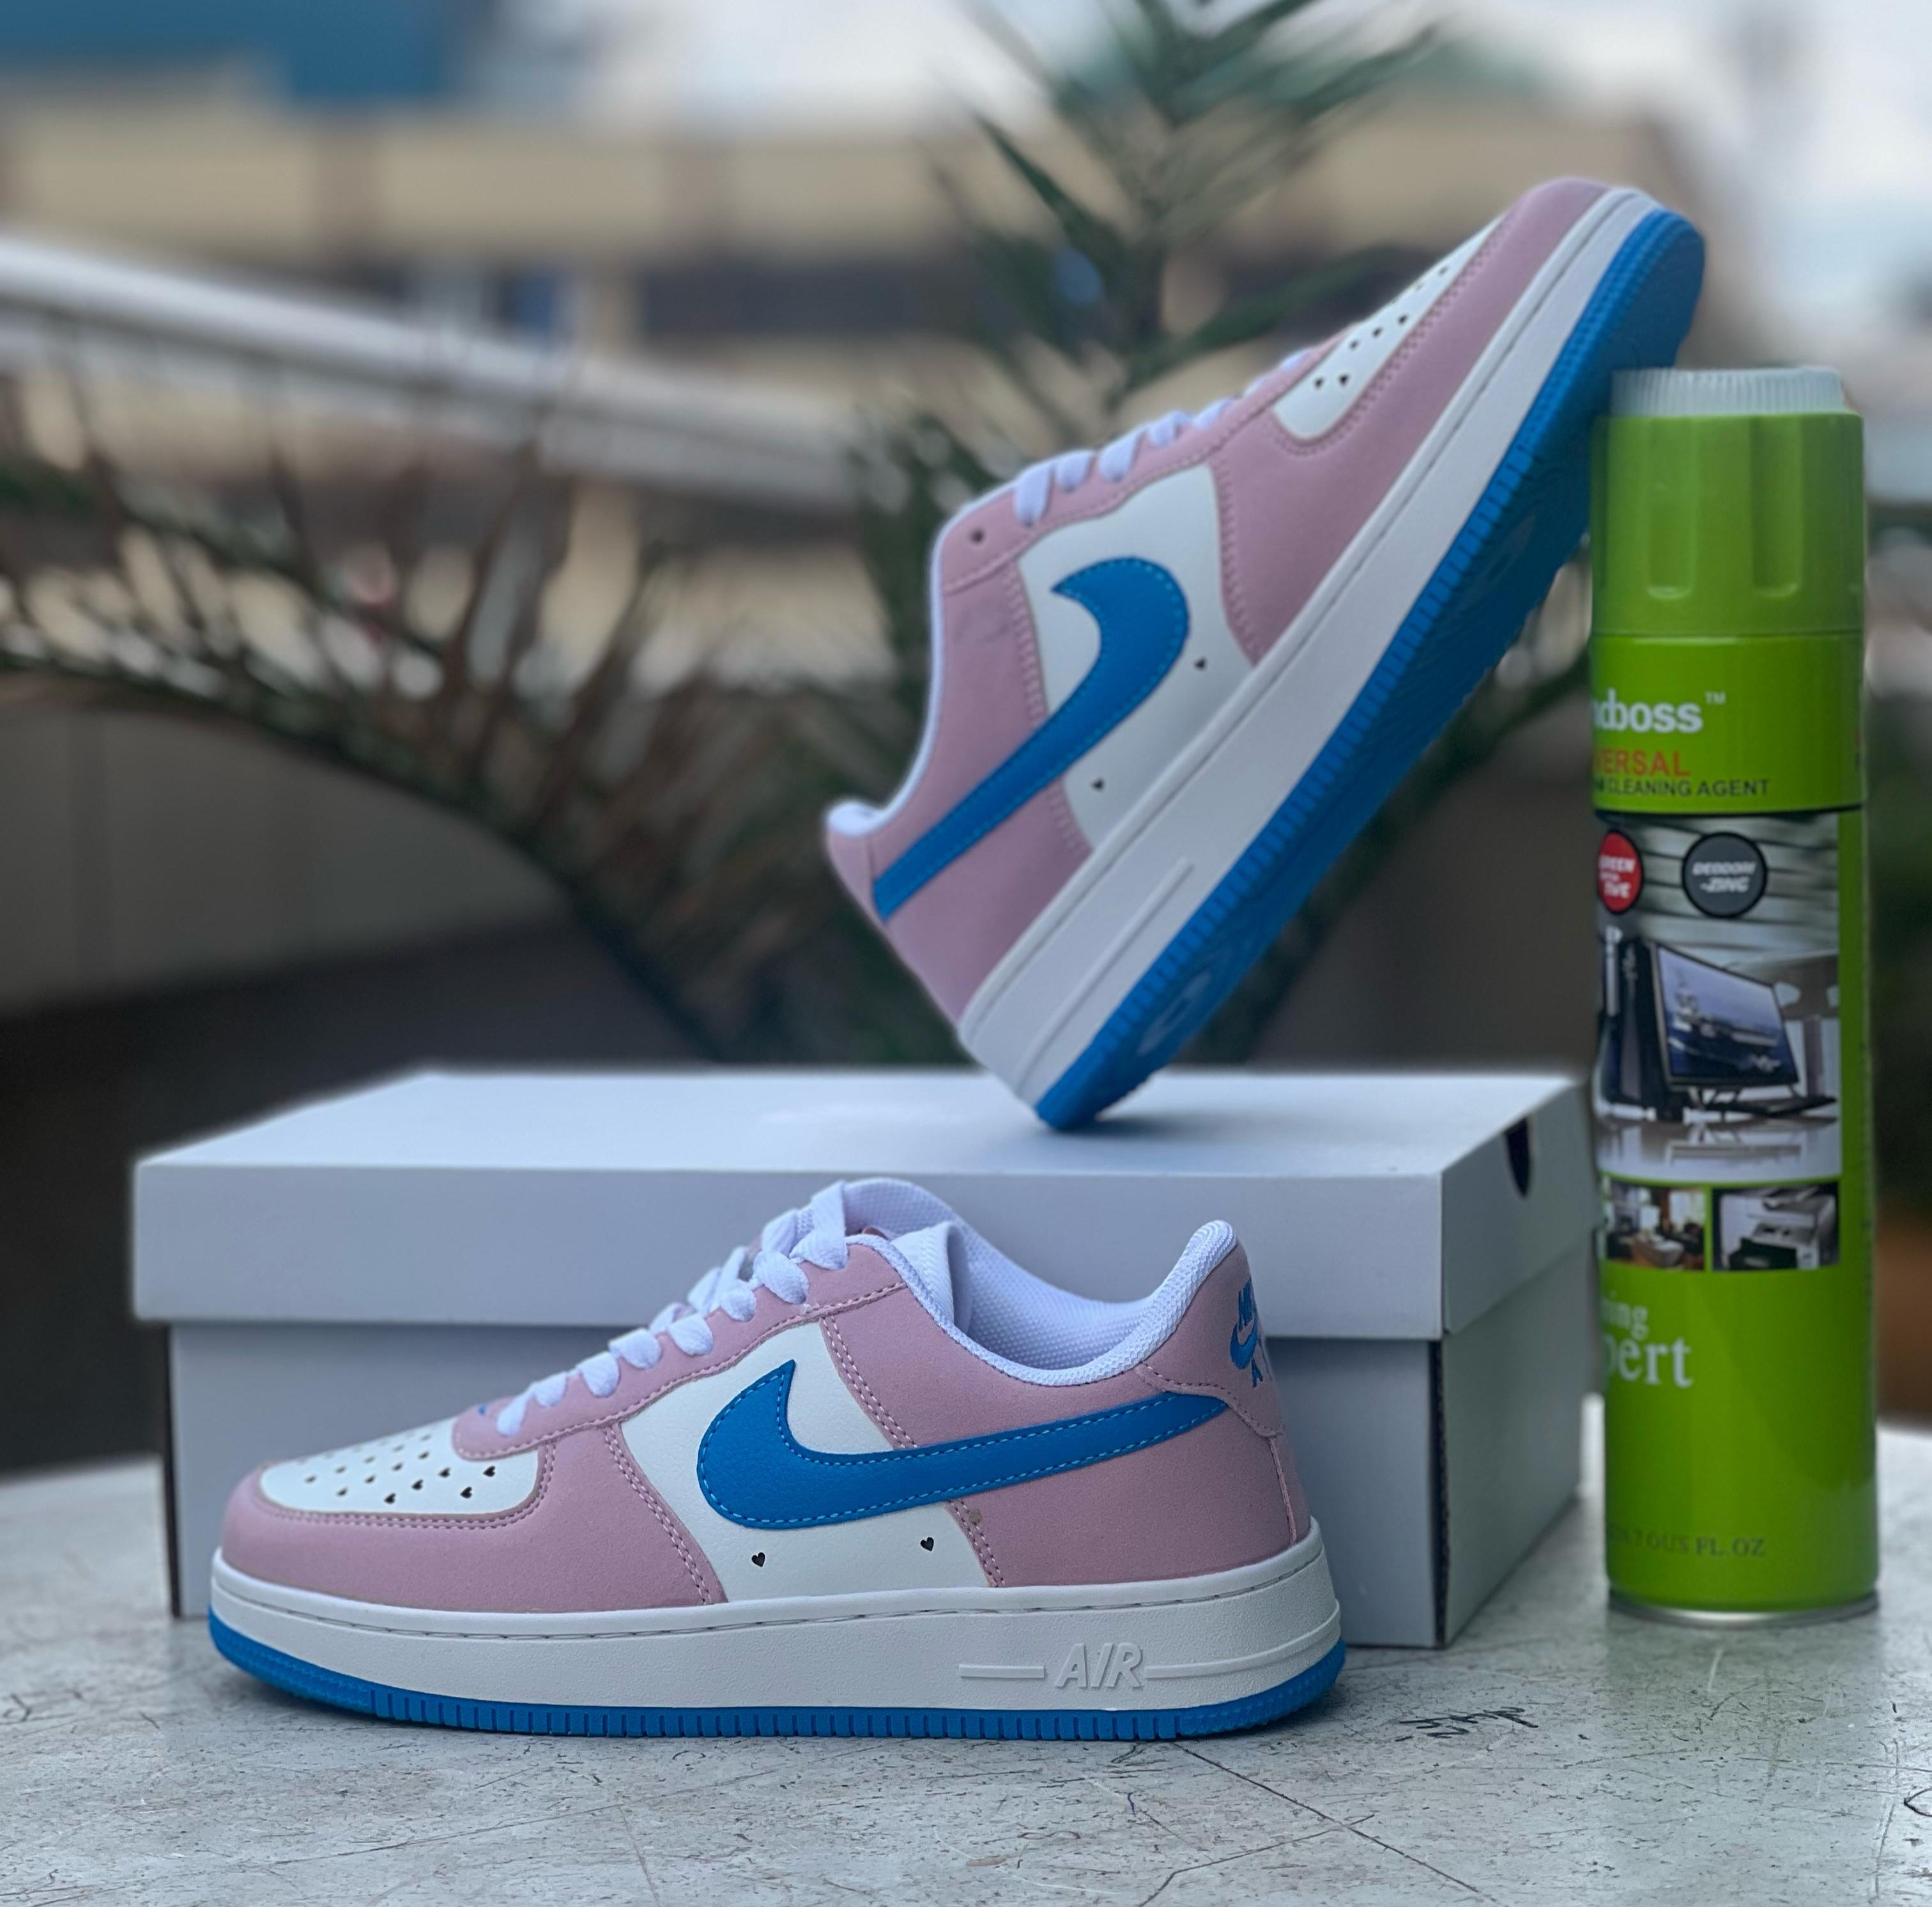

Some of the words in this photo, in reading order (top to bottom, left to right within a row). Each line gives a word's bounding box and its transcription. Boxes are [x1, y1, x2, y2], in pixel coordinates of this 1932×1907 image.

[1605, 776, 1692, 797] CLEANING
[1696, 777, 1772, 797] AGENT
[1055, 1642, 1144, 1690] AIR
